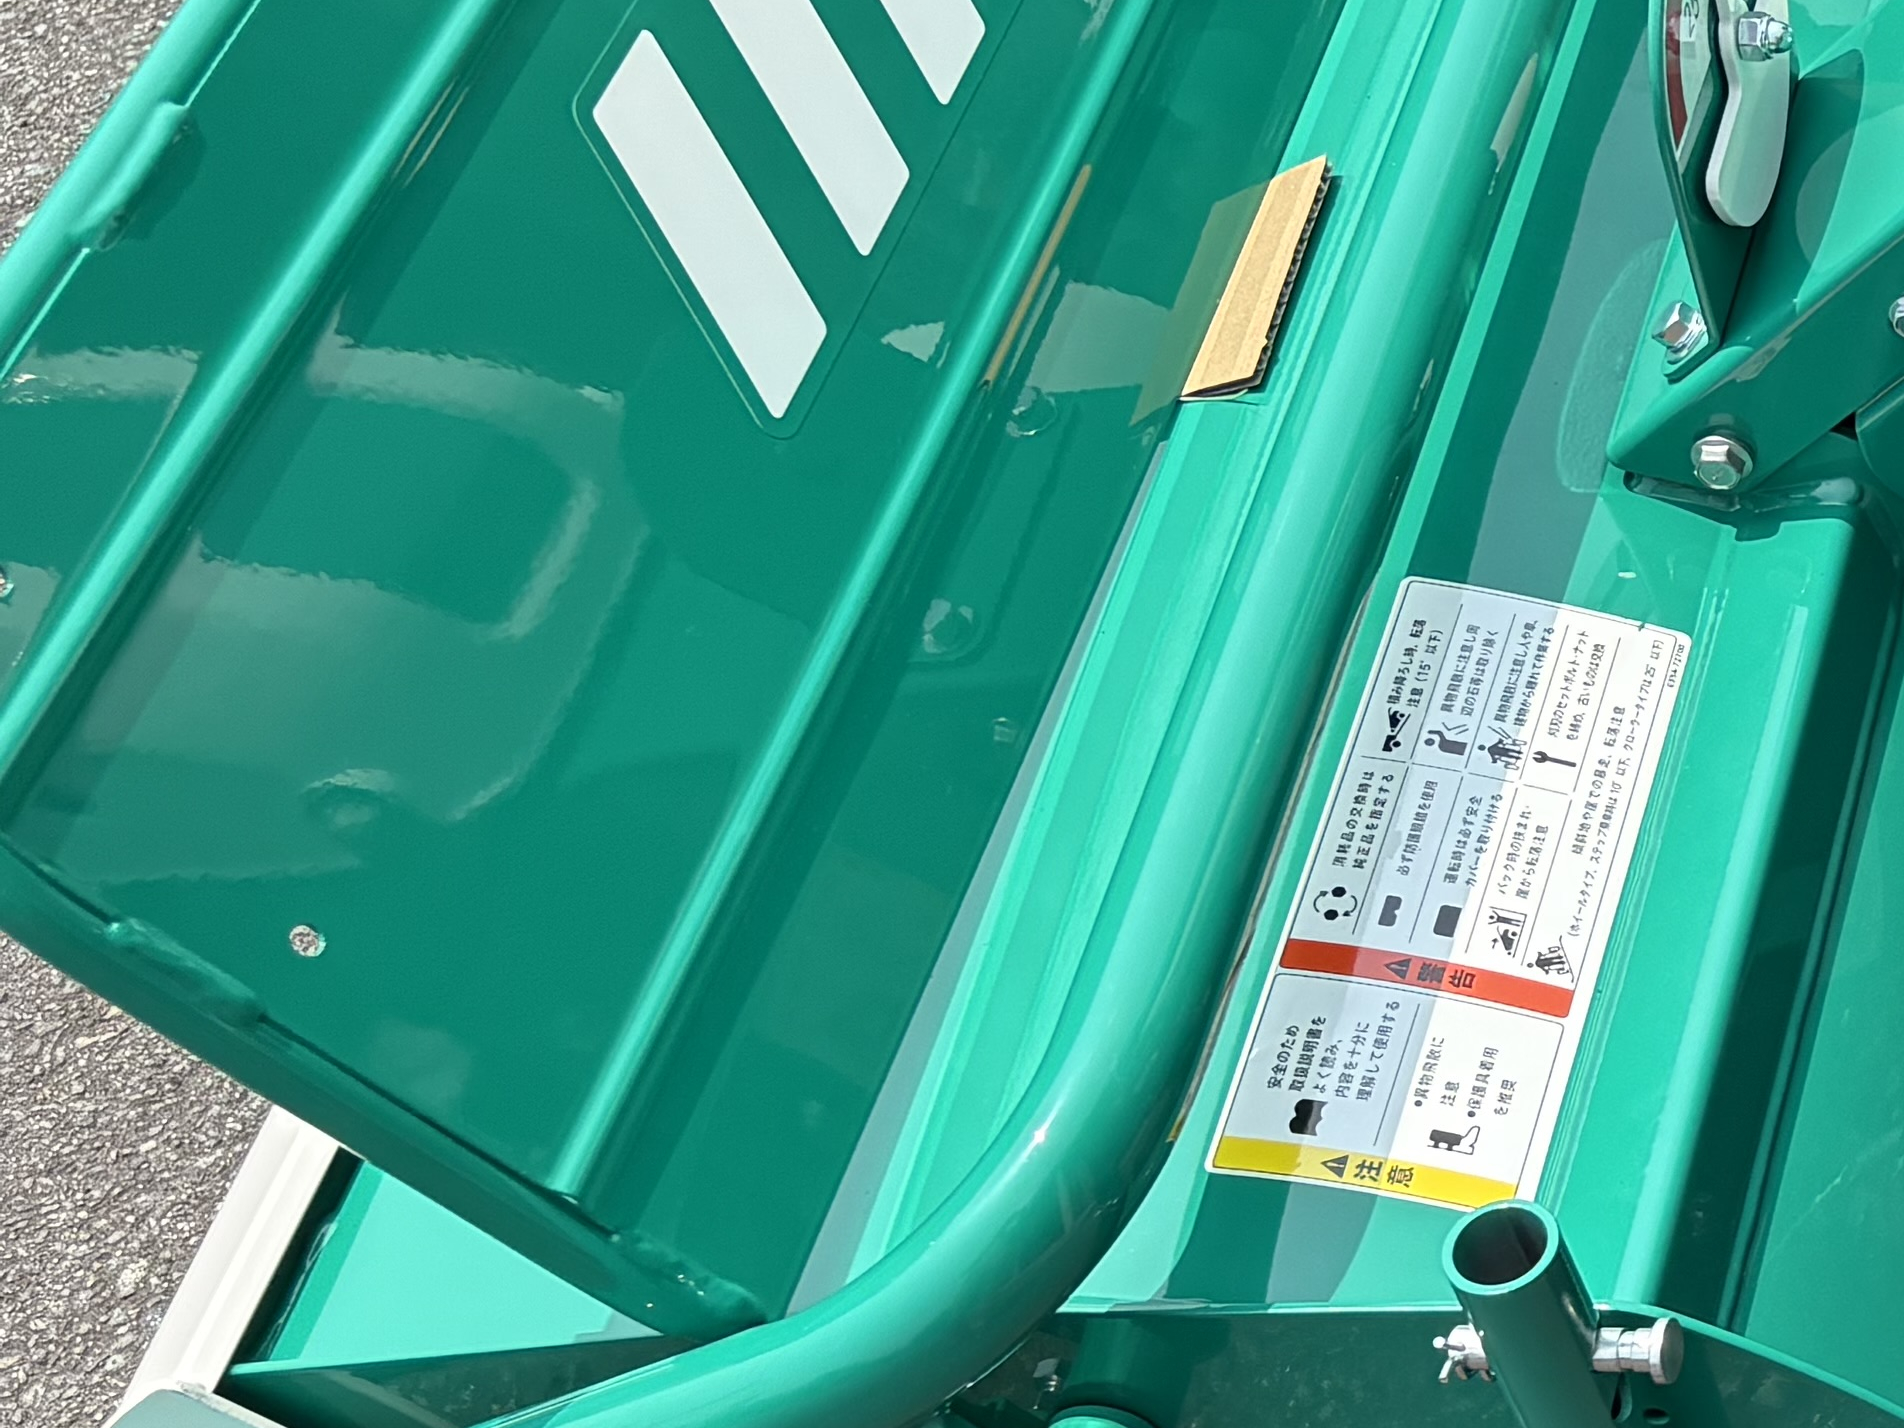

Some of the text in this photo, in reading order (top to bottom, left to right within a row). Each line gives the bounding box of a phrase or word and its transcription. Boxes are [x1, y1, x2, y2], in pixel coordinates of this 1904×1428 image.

[1442, 793, 1484, 885] 運転時は必ず安全
[1462, 792, 1505, 887] カバーを取り付ける
[1414, 960, 1478, 990] 警告
[1264, 1023, 1301, 1090] 安全のため
[1287, 1014, 1328, 1092] 取扱説明書を
[1332, 1020, 1371, 1098] 内容を十分に
[1354, 999, 1401, 1102] 理解して使用する
[1438, 1079, 1460, 1107] 注意
[1351, 1157, 1416, 1188] 注意
